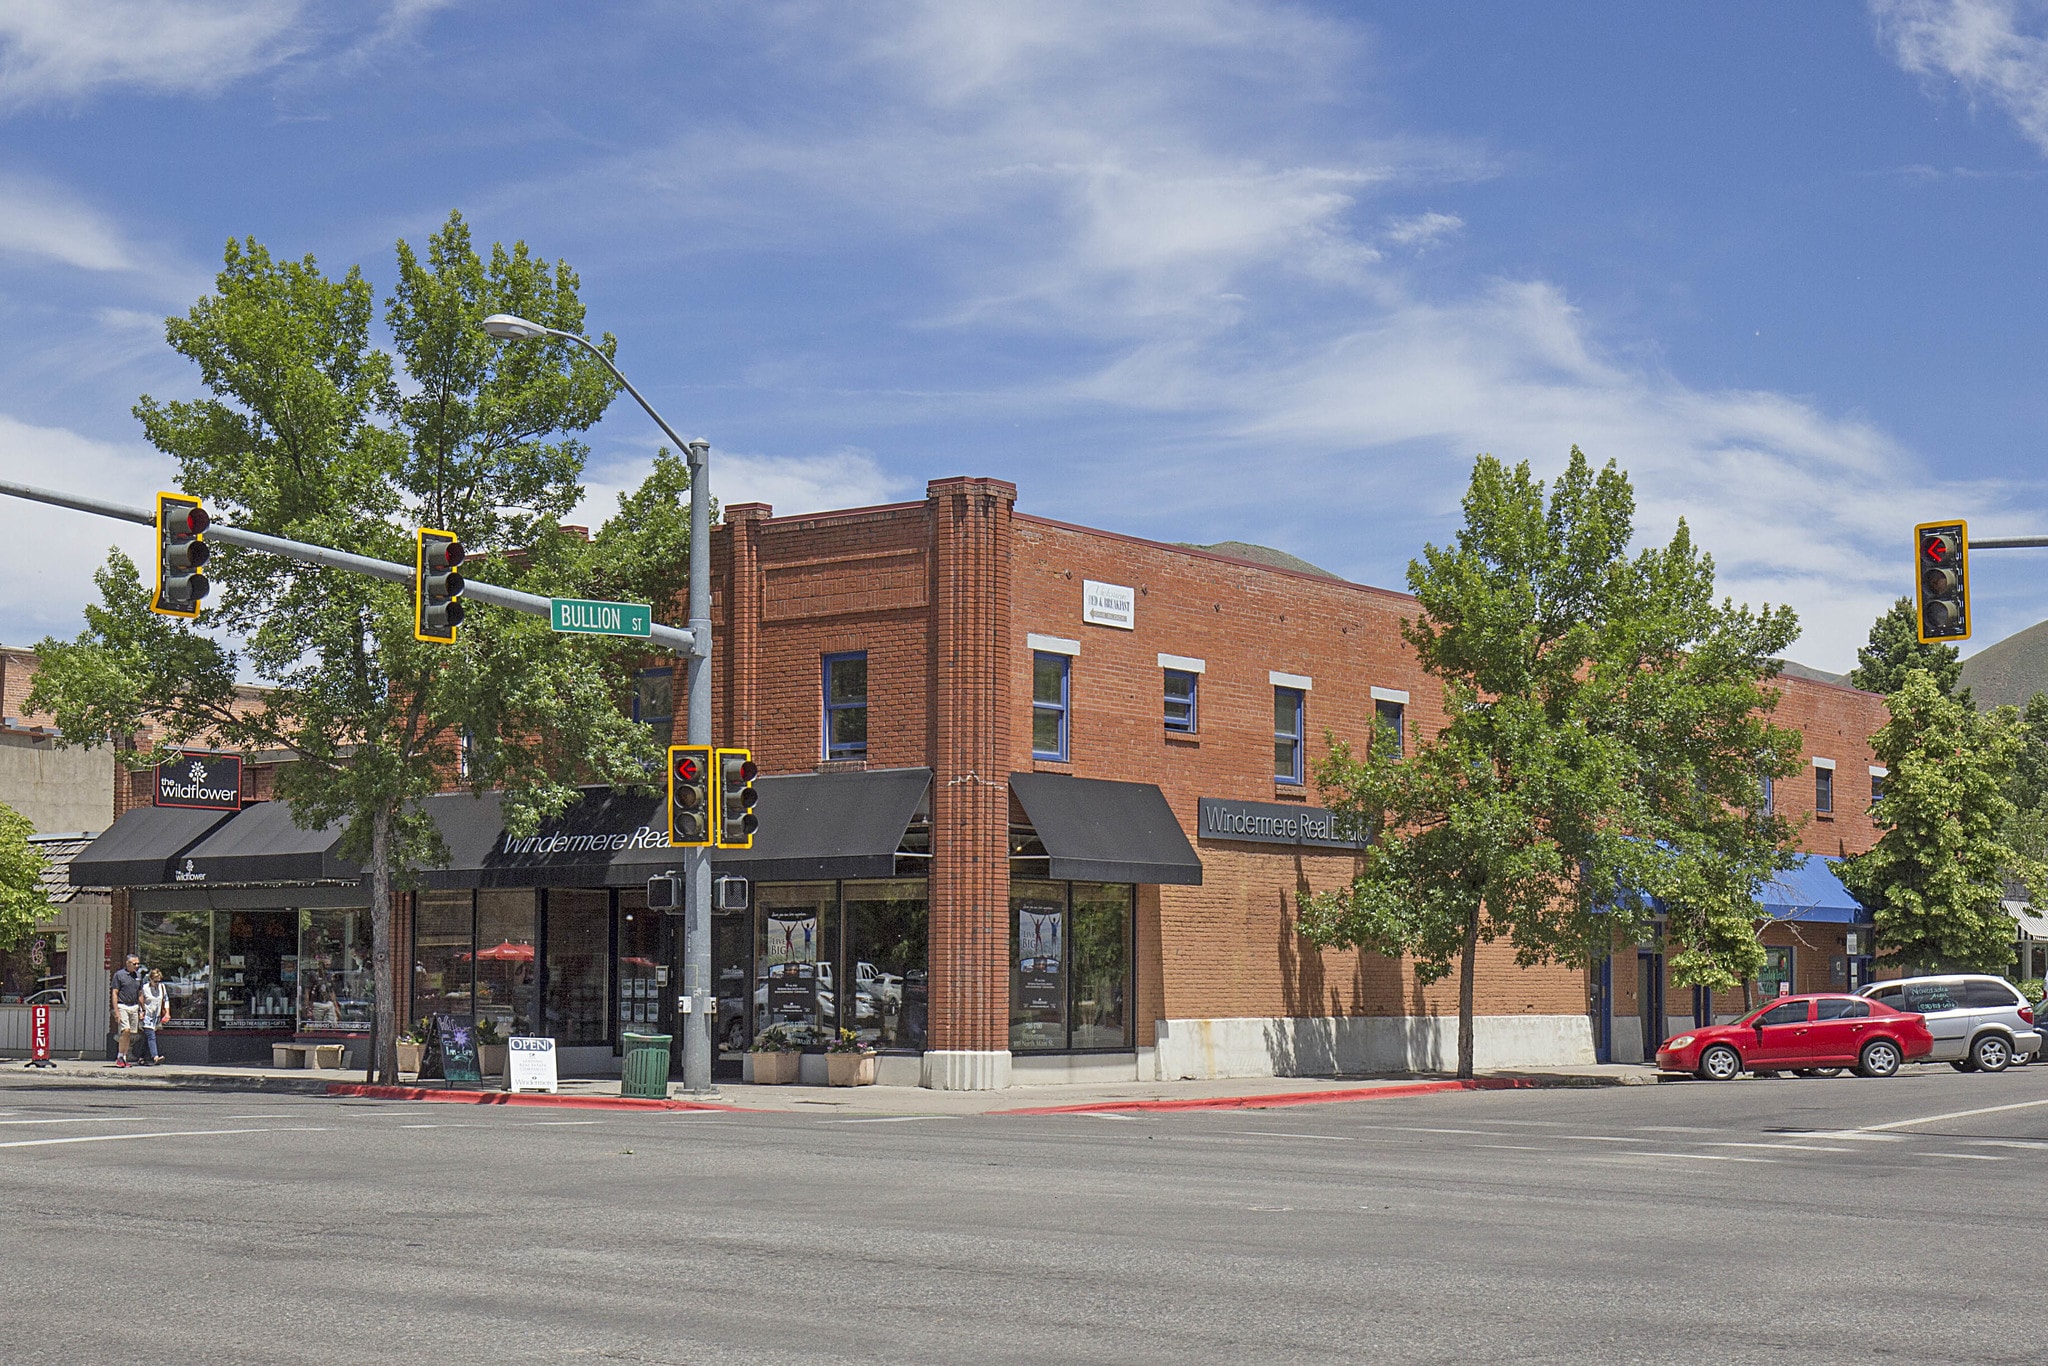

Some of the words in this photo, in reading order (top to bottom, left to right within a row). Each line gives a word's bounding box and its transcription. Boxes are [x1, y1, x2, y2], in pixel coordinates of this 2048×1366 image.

[561, 604, 621, 630] BULLION
[632, 617, 642, 631] ST
[161, 777, 175, 787] the
[161, 781, 237, 801] wildflower
[1206, 806, 1297, 837] Windermere
[1301, 813, 1329, 840] Real
[503, 830, 628, 854] Windermere
[628, 826, 672, 849] Rea
[175, 872, 206, 881] wildflower
[771, 945, 786, 955] BIG
[1022, 938, 1036, 949] BIG
[36, 1007, 46, 1047] OPEN
[511, 1039, 547, 1050] OPEN
